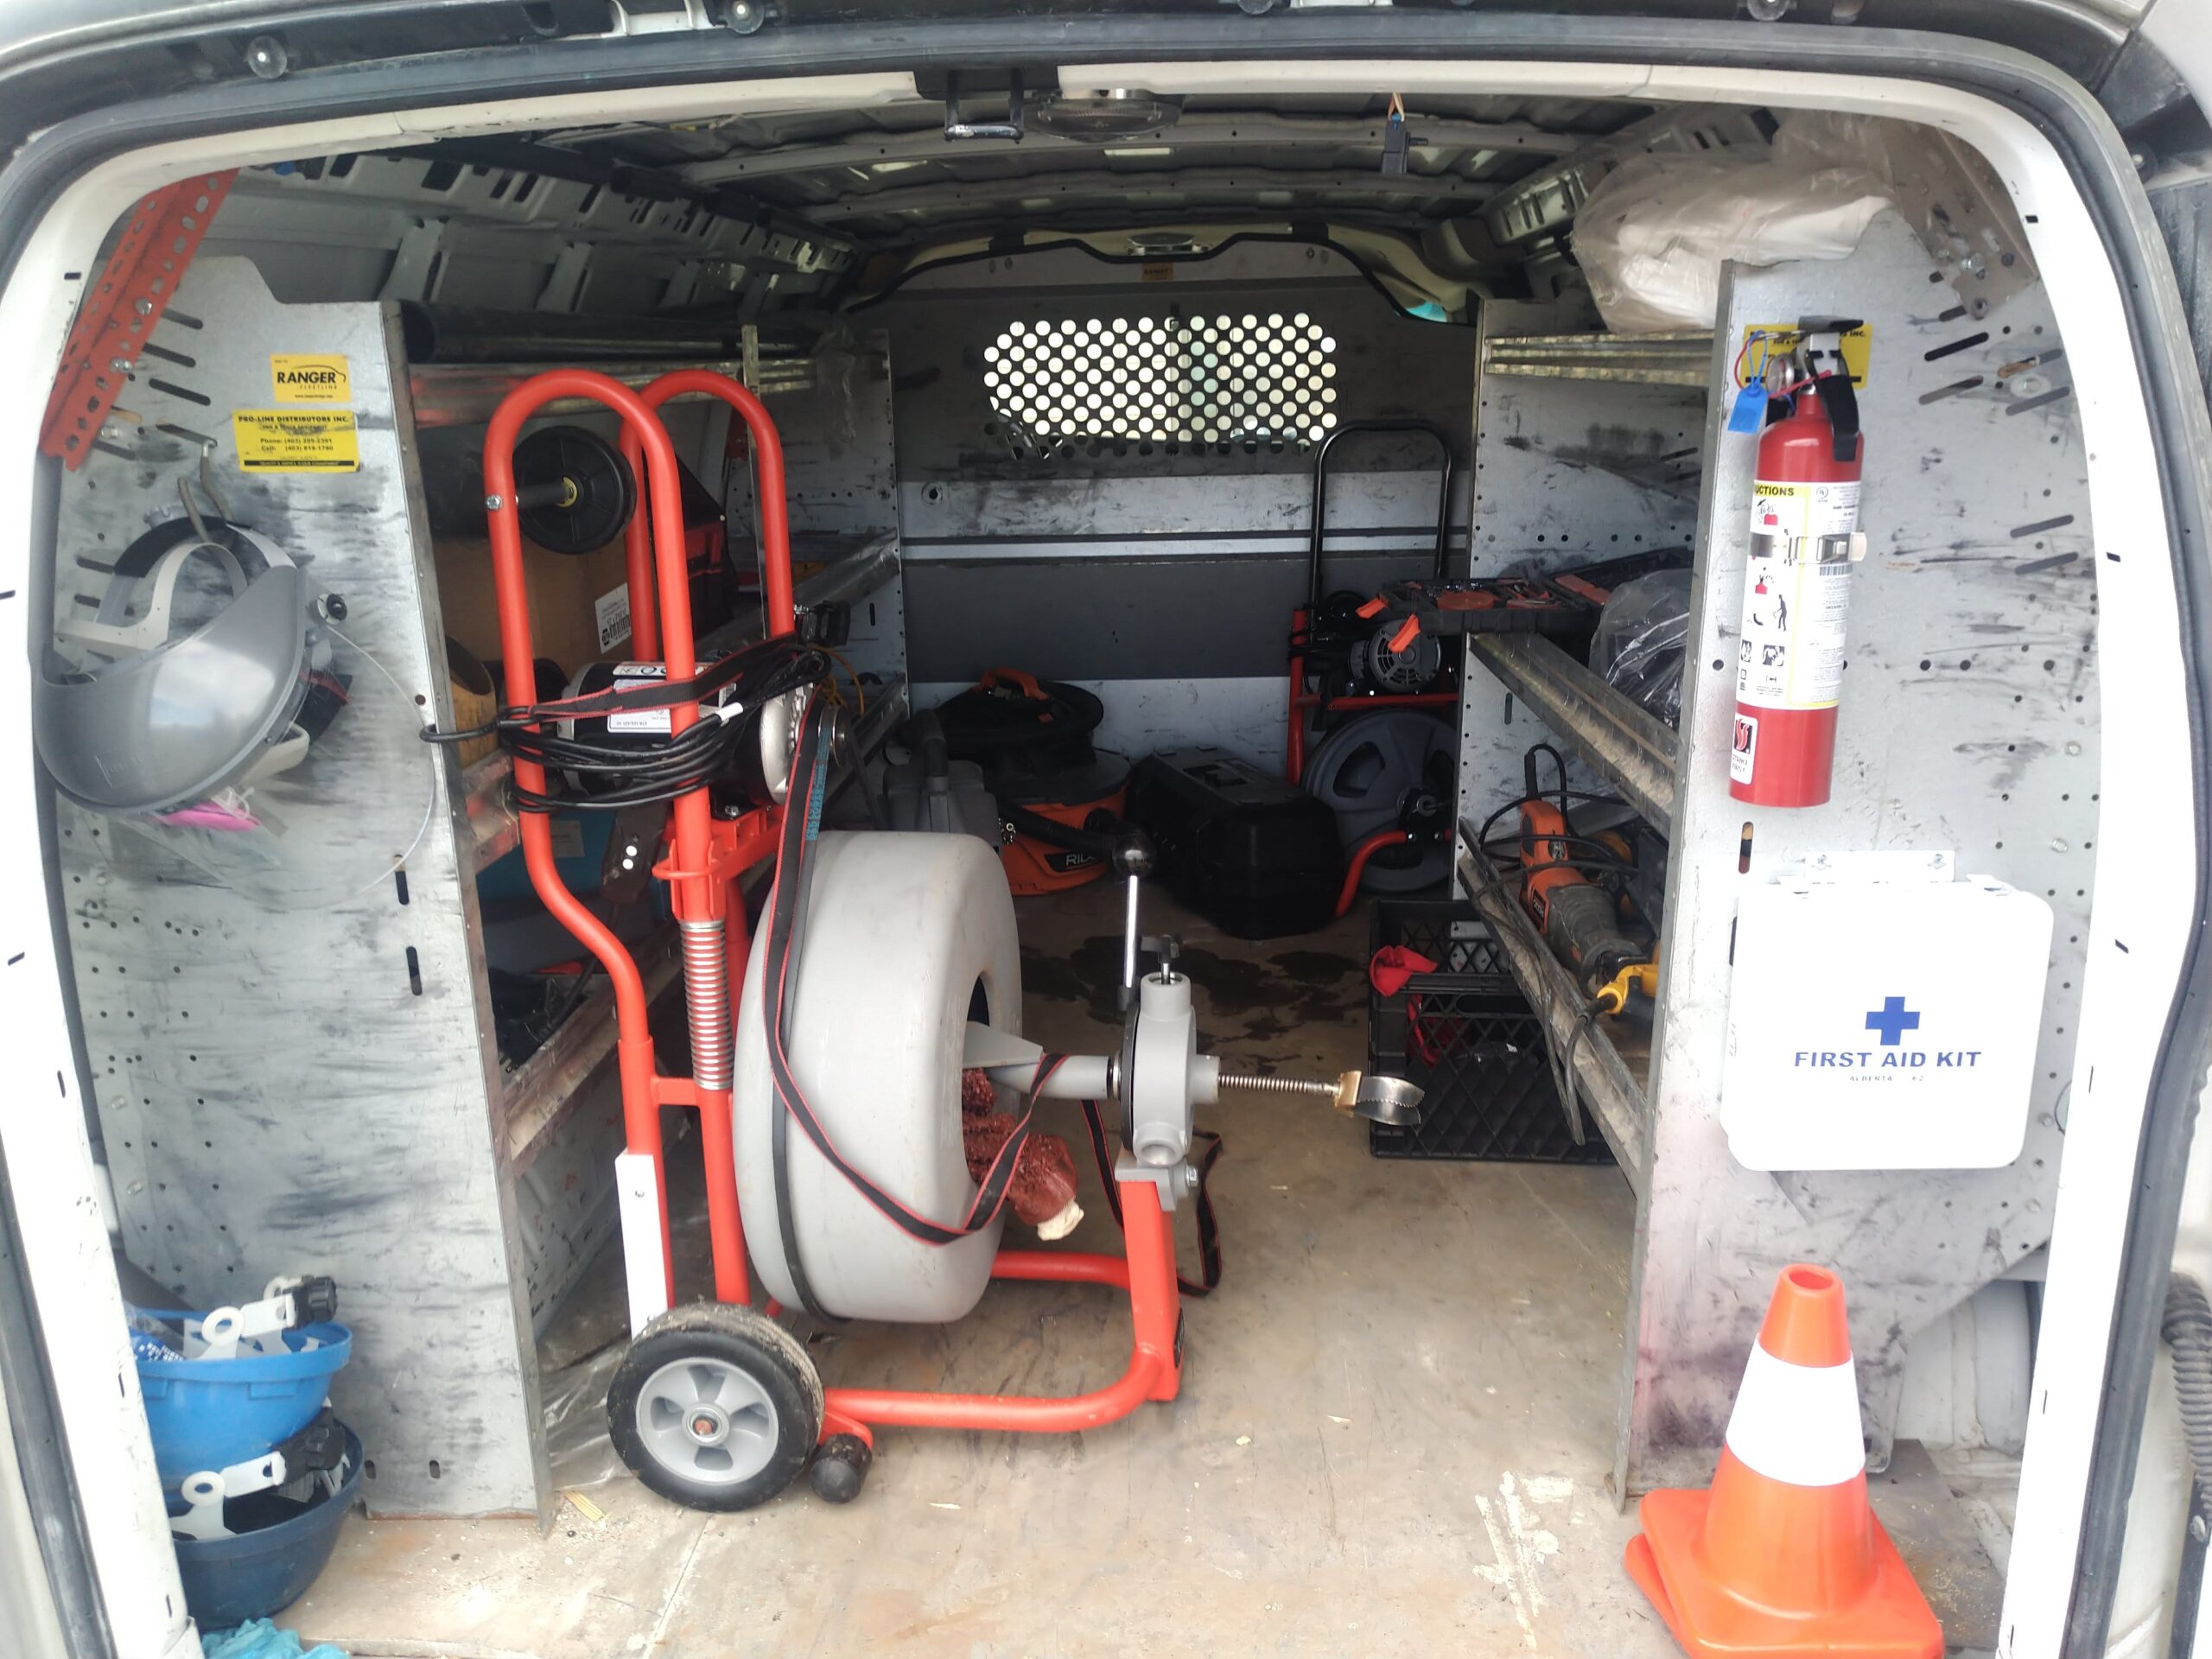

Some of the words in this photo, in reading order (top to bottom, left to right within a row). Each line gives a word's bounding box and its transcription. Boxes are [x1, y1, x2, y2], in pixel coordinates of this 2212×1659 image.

[277, 372, 336, 384] RANGER
[1755, 485, 1795, 497] UCTIONS
[1795, 1052, 1872, 1068] FIRST
[1881, 1052, 1926, 1068] AID
[1936, 1052, 1982, 1068] KIT
